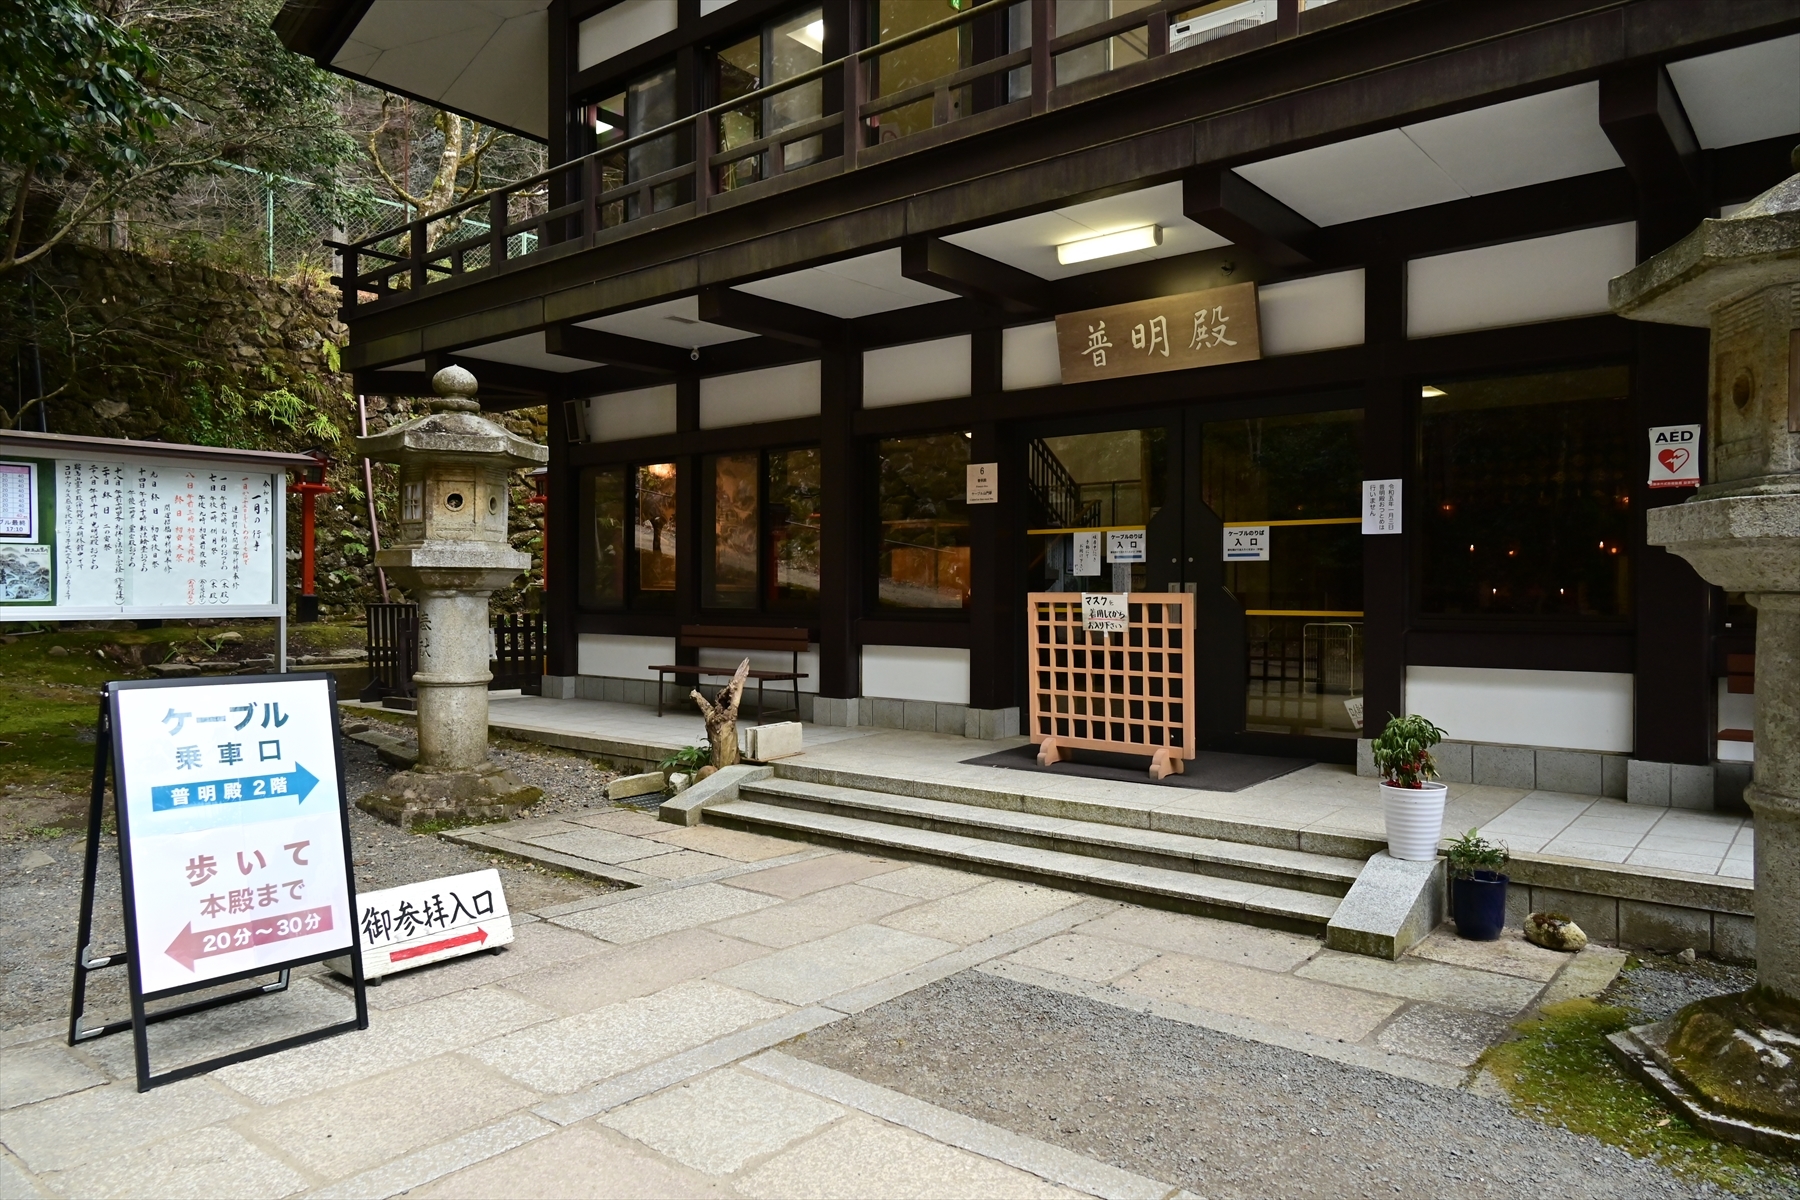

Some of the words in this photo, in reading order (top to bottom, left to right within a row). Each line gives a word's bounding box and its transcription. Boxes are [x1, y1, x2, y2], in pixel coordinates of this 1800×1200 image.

[1081, 305, 1238, 367] 普明殿
[1655, 430, 1694, 443] AED
[979, 467, 985, 475] 6
[262, 480, 271, 515] 令和五年
[252, 494, 262, 552] 一月の行事
[1117, 541, 1137, 549] 入口
[1235, 538, 1258, 546] 入口
[1088, 621, 1122, 630] お入り下さい
[1089, 608, 1126, 620] 着用してから
[161, 702, 290, 736] ケーブル
[175, 739, 282, 771] 乗車口
[170, 783, 243, 805] 普明殿
[252, 777, 288, 797] 2階
[185, 841, 311, 887] 歩いて
[200, 880, 307, 919] 本殿まで
[360, 889, 494, 944] 御参拝入口
